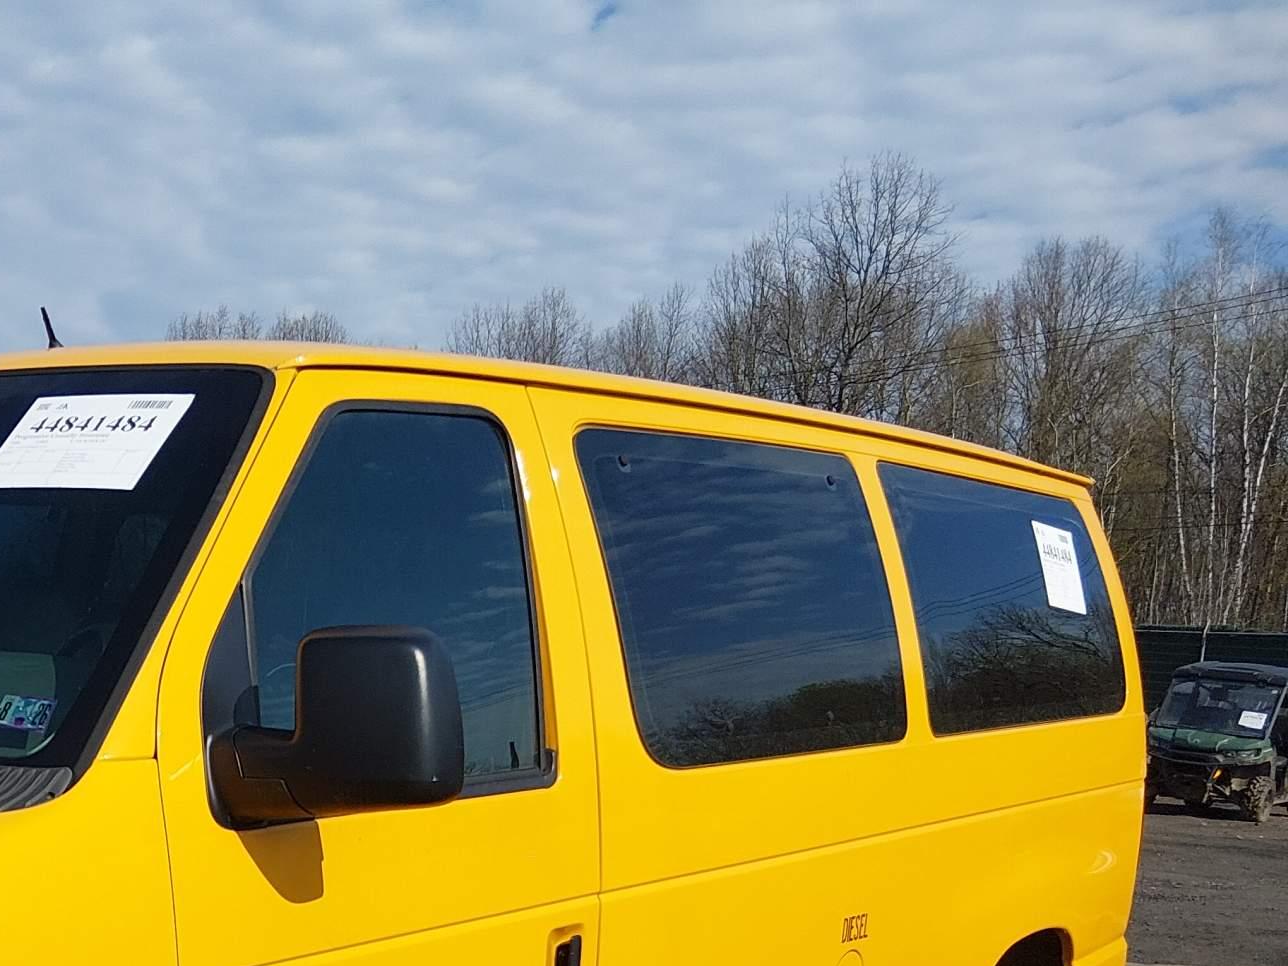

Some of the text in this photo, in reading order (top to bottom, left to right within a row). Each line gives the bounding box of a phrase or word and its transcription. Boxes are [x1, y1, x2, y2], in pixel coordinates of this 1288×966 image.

[30, 415, 158, 433] 44841484
[1042, 543, 1073, 565] 44841484
[841, 913, 868, 943] DIESEL
